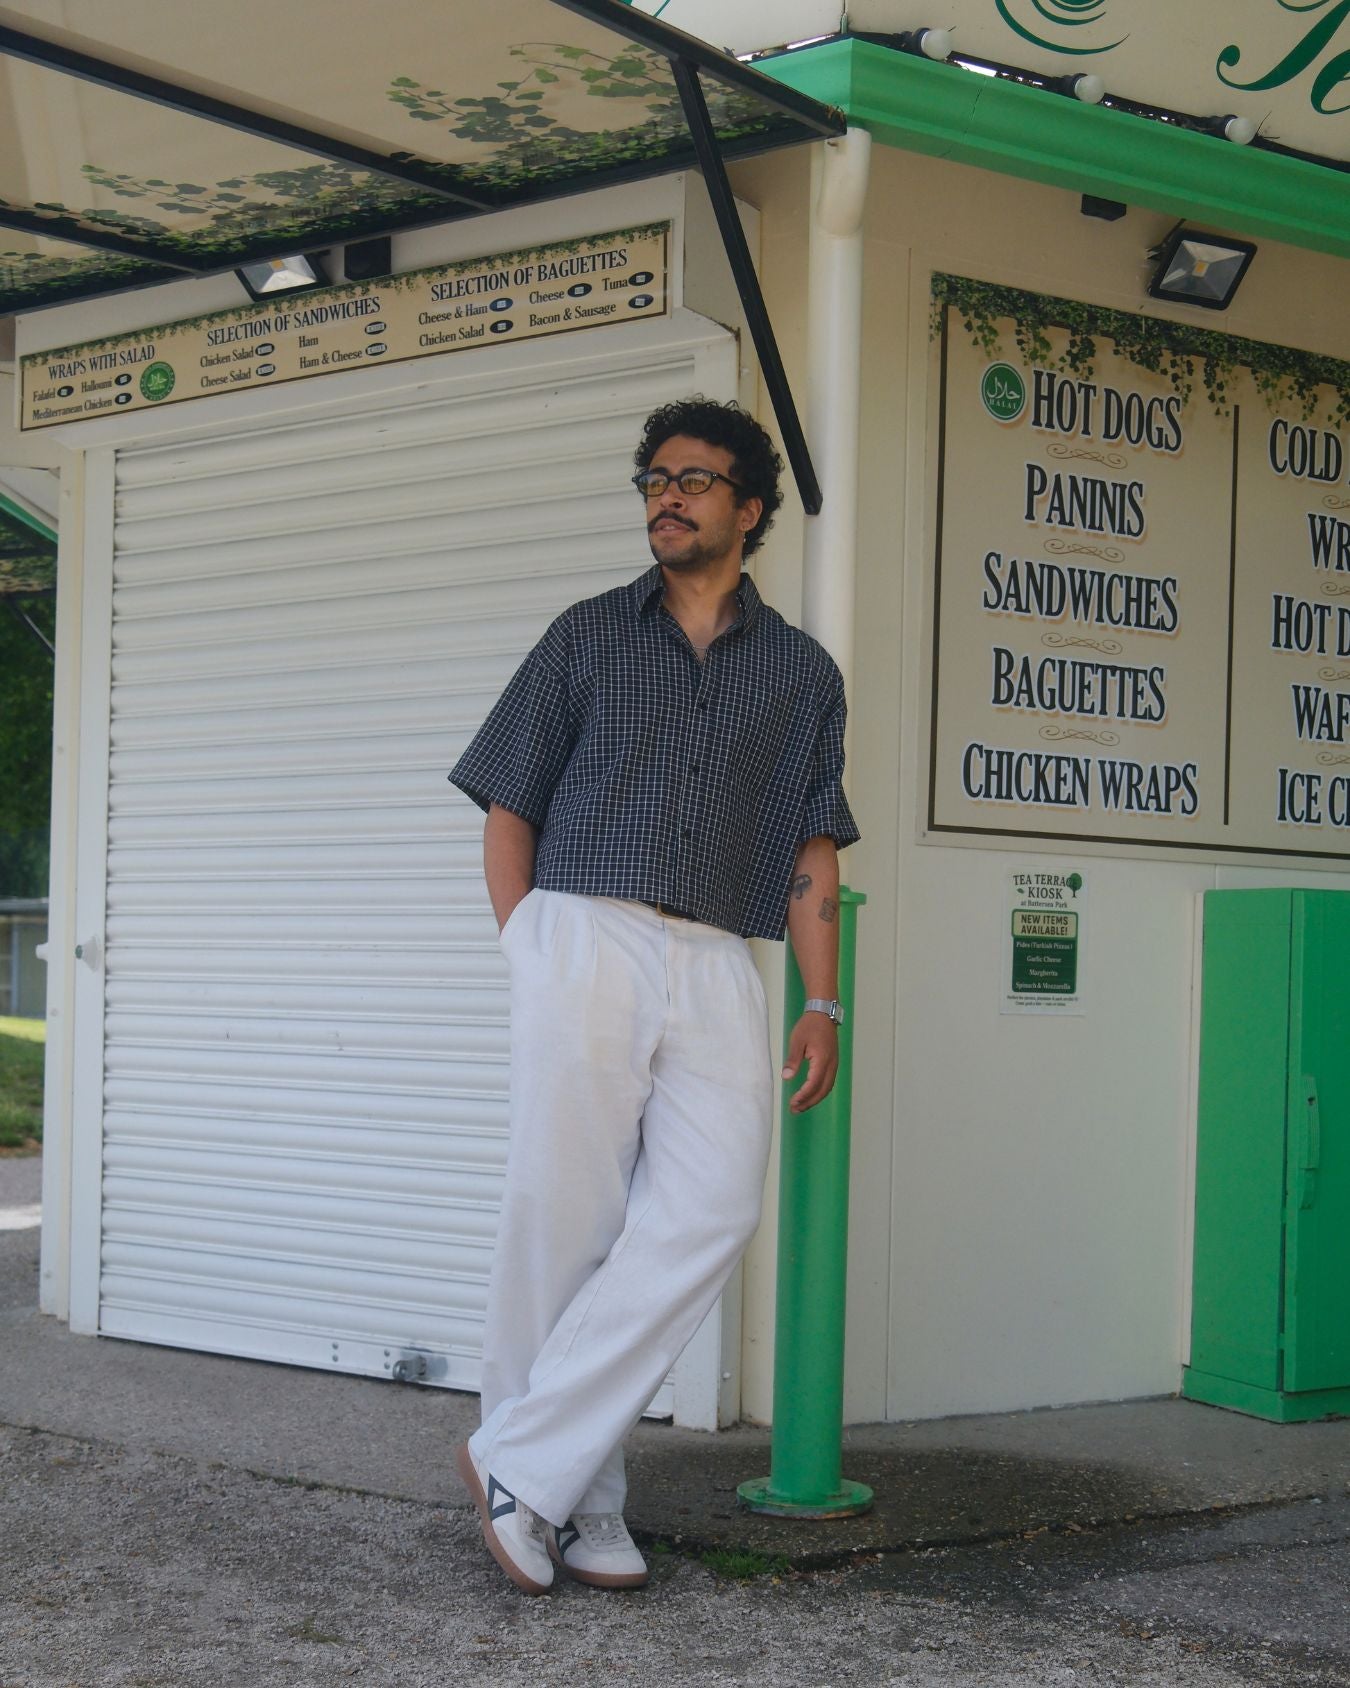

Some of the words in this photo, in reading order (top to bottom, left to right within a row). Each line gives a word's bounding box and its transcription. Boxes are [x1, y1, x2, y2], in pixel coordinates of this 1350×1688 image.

[431, 273, 510, 302] SELECTION
[513, 266, 534, 286] OF
[537, 248, 628, 282] BAGUETTES
[602, 277, 629, 292] Tuna
[529, 289, 565, 305] Cheese
[207, 318, 271, 347] SELECTION
[274, 315, 290, 333] OF
[294, 296, 381, 329] SANDWICHES
[418, 310, 452, 326] Cheese
[454, 306, 463, 319] &
[465, 303, 488, 317] Ham
[529, 313, 561, 328] Bacon
[563, 308, 572, 321] &
[574, 302, 617, 320] Sausage
[298, 335, 319, 349] Ham
[419, 329, 457, 347] Chicken
[458, 324, 485, 340] Salad
[48, 359, 87, 381] WRAPS
[89, 352, 117, 373] WITH
[119, 344, 155, 366] SALAD
[200, 351, 231, 368] Chicken
[232, 346, 254, 362] Salad
[299, 356, 320, 369] Ham
[321, 354, 330, 365] &
[331, 350, 363, 363] Cheese
[81, 377, 112, 394] Halloumi
[200, 374, 228, 388] Cheese
[229, 368, 251, 382] Salad
[987, 376, 1020, 399] حلال
[32, 388, 56, 402] Falafel
[32, 403, 83, 421] Mediterranean
[84, 397, 113, 411] Chicken
[1031, 369, 1096, 437] HOT
[1103, 387, 1182, 452] DOGS
[1269, 418, 1342, 482] COLD
[1024, 463, 1145, 538] PANINIS
[983, 551, 1178, 632] SANDWICHES
[1272, 594, 1331, 654] HOT
[992, 647, 1166, 722] BAGUETTES
[963, 743, 1092, 807] CHICKEN
[1098, 760, 1198, 815] WRAPS
[1278, 768, 1321, 824] ICE
[1013, 874, 1032, 886] TEA
[1028, 886, 1063, 900] KIOSK
[1055, 901, 1068, 909] Park
[1021, 914, 1041, 924] NEW
[1043, 915, 1068, 925] ITEMS
[1021, 925, 1068, 936] AVAILABLE!
